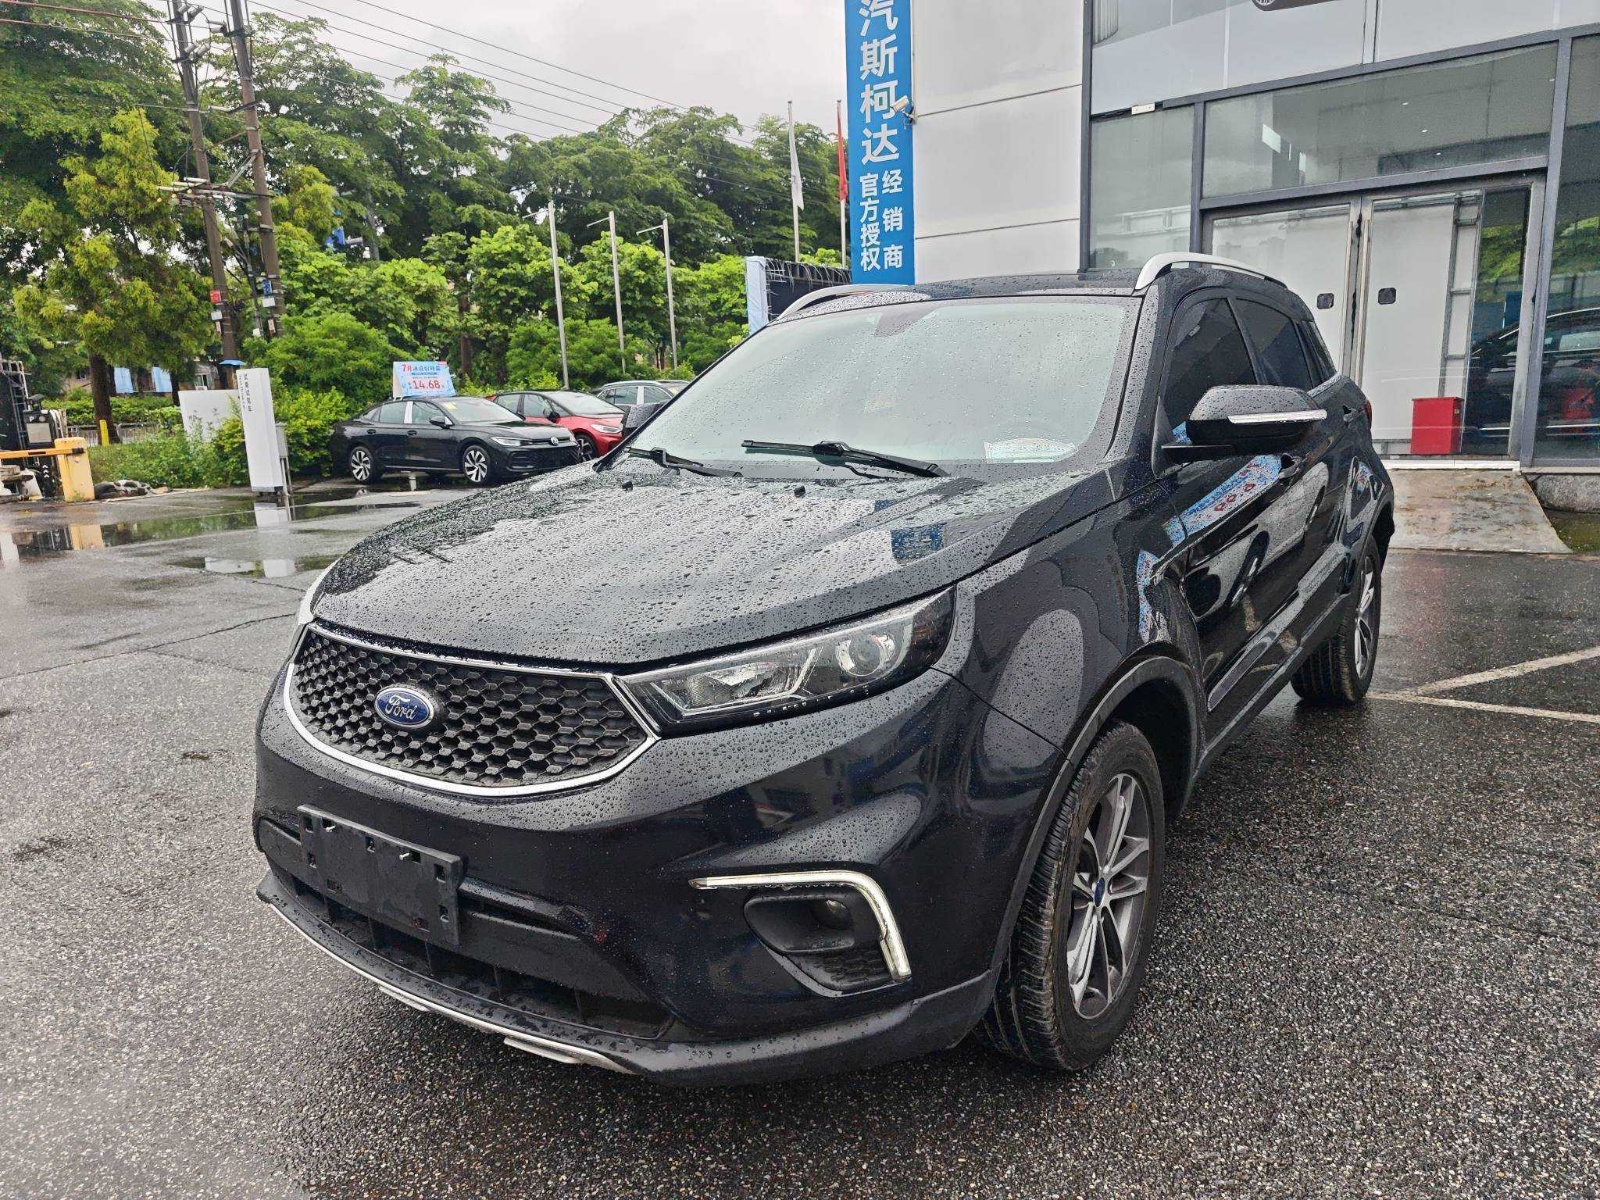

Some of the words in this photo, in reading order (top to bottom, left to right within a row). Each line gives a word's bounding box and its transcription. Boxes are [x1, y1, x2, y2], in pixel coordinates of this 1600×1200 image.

[859, 172, 881, 272] 官方授权
[881, 169, 903, 270] 经销商
[385, 694, 418, 720] Ford
